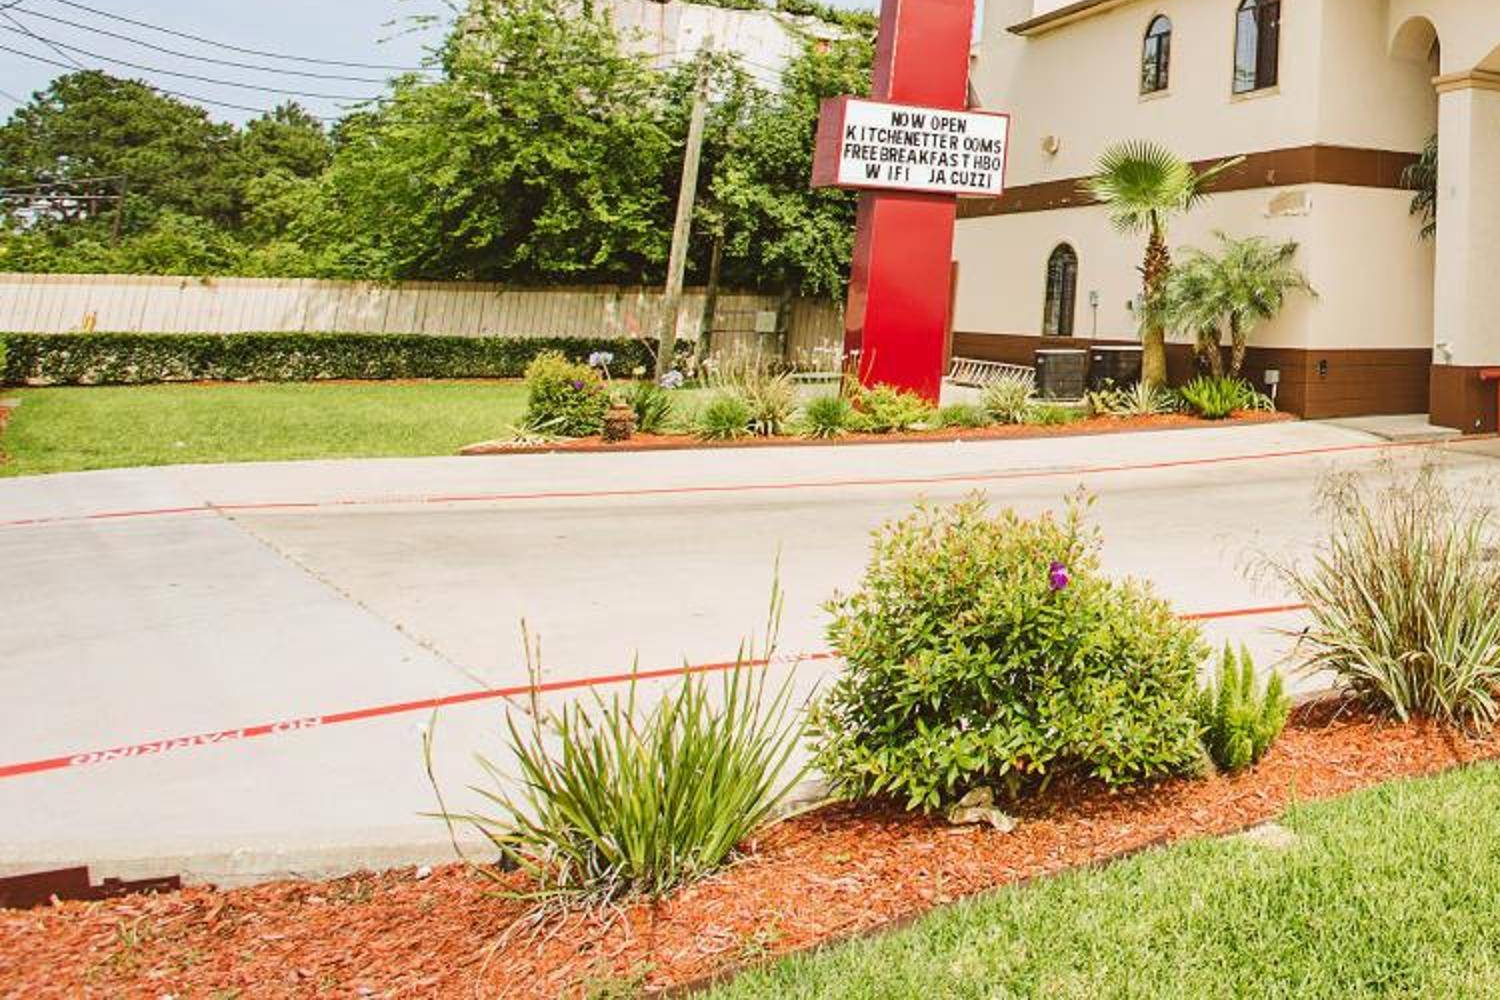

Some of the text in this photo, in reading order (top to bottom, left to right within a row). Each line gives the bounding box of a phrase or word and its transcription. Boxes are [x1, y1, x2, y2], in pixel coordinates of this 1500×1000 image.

[891, 112, 967, 133] NOW OPEN
[973, 155, 1001, 171] HBO
[69, 728, 244, 765] PARKING
